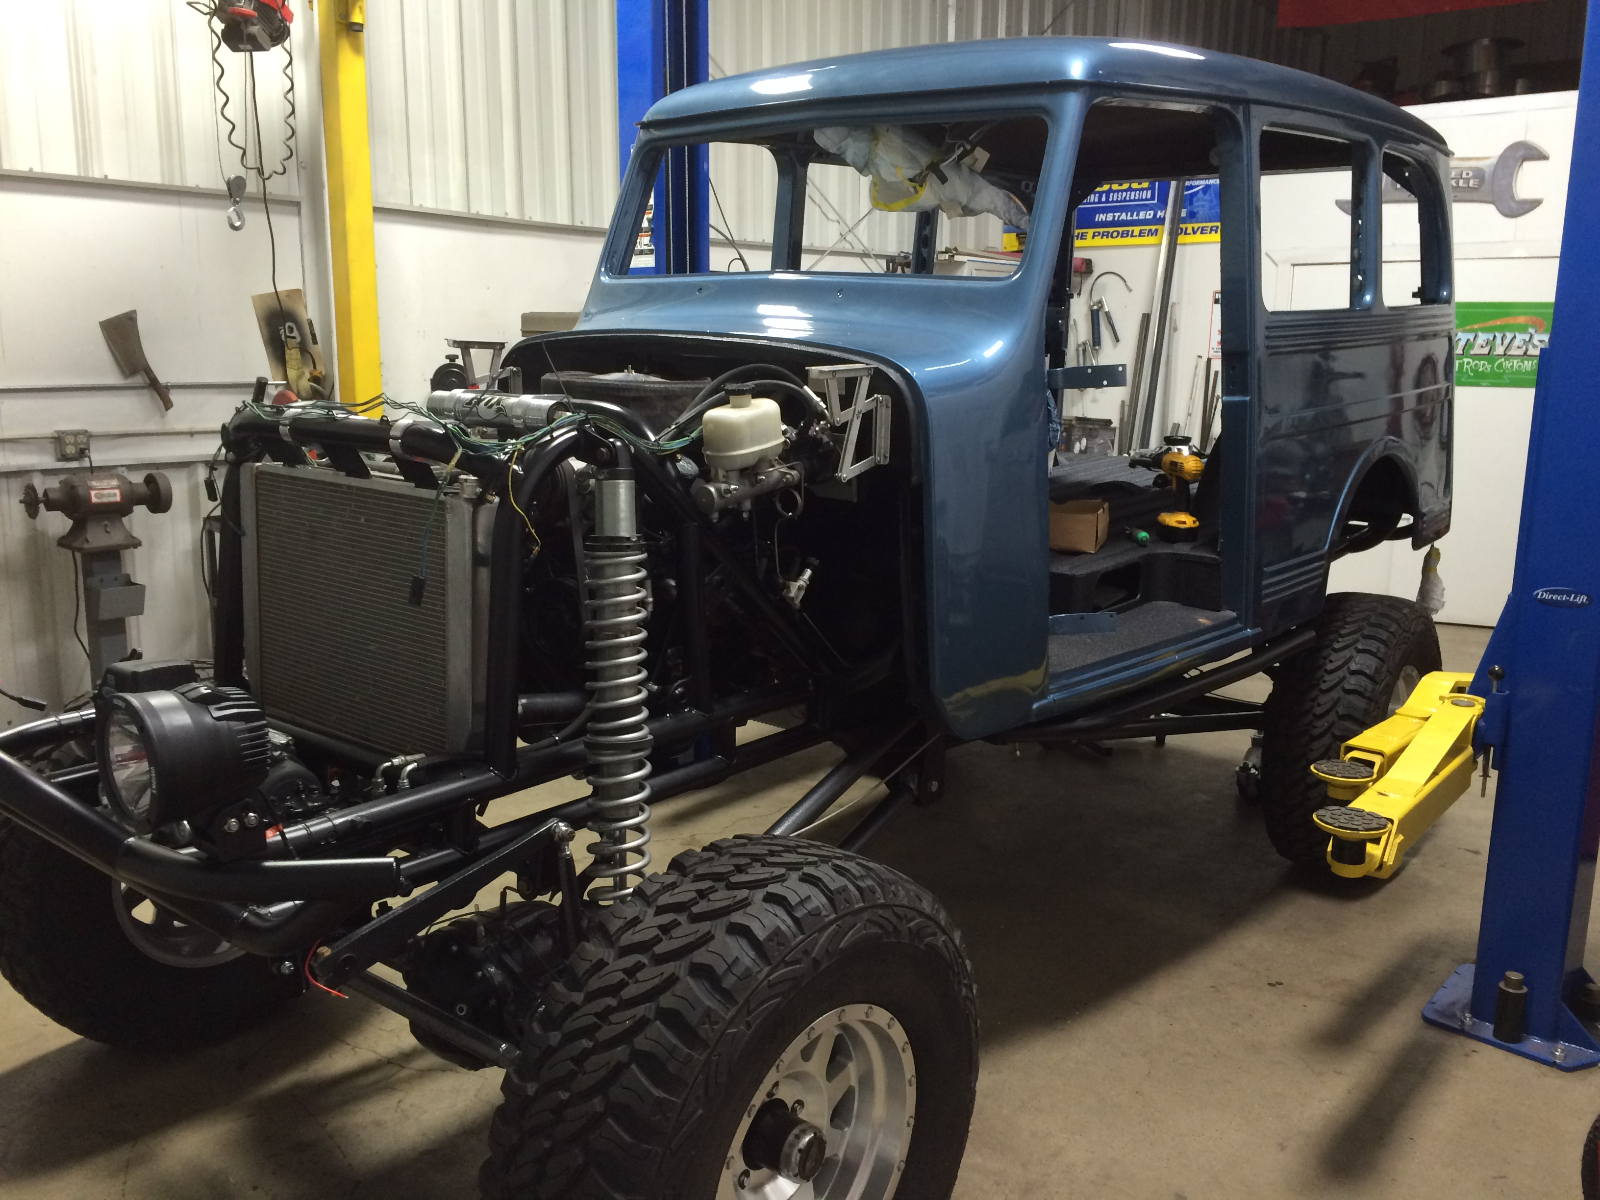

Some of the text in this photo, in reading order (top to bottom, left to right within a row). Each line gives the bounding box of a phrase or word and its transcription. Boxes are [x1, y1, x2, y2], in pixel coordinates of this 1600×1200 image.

[1451, 170, 1473, 178] ED
[1451, 179, 1479, 188] KLE
[1101, 193, 1107, 202] &
[1109, 189, 1152, 202] SUSPENSION
[1095, 210, 1154, 221] INSTALLED
[1075, 231, 1089, 241] HE
[1091, 228, 1159, 240] PROBLEM
[1456, 328, 1550, 357] TEVE'S
[1537, 591, 1588, 604] Direct-Lift
